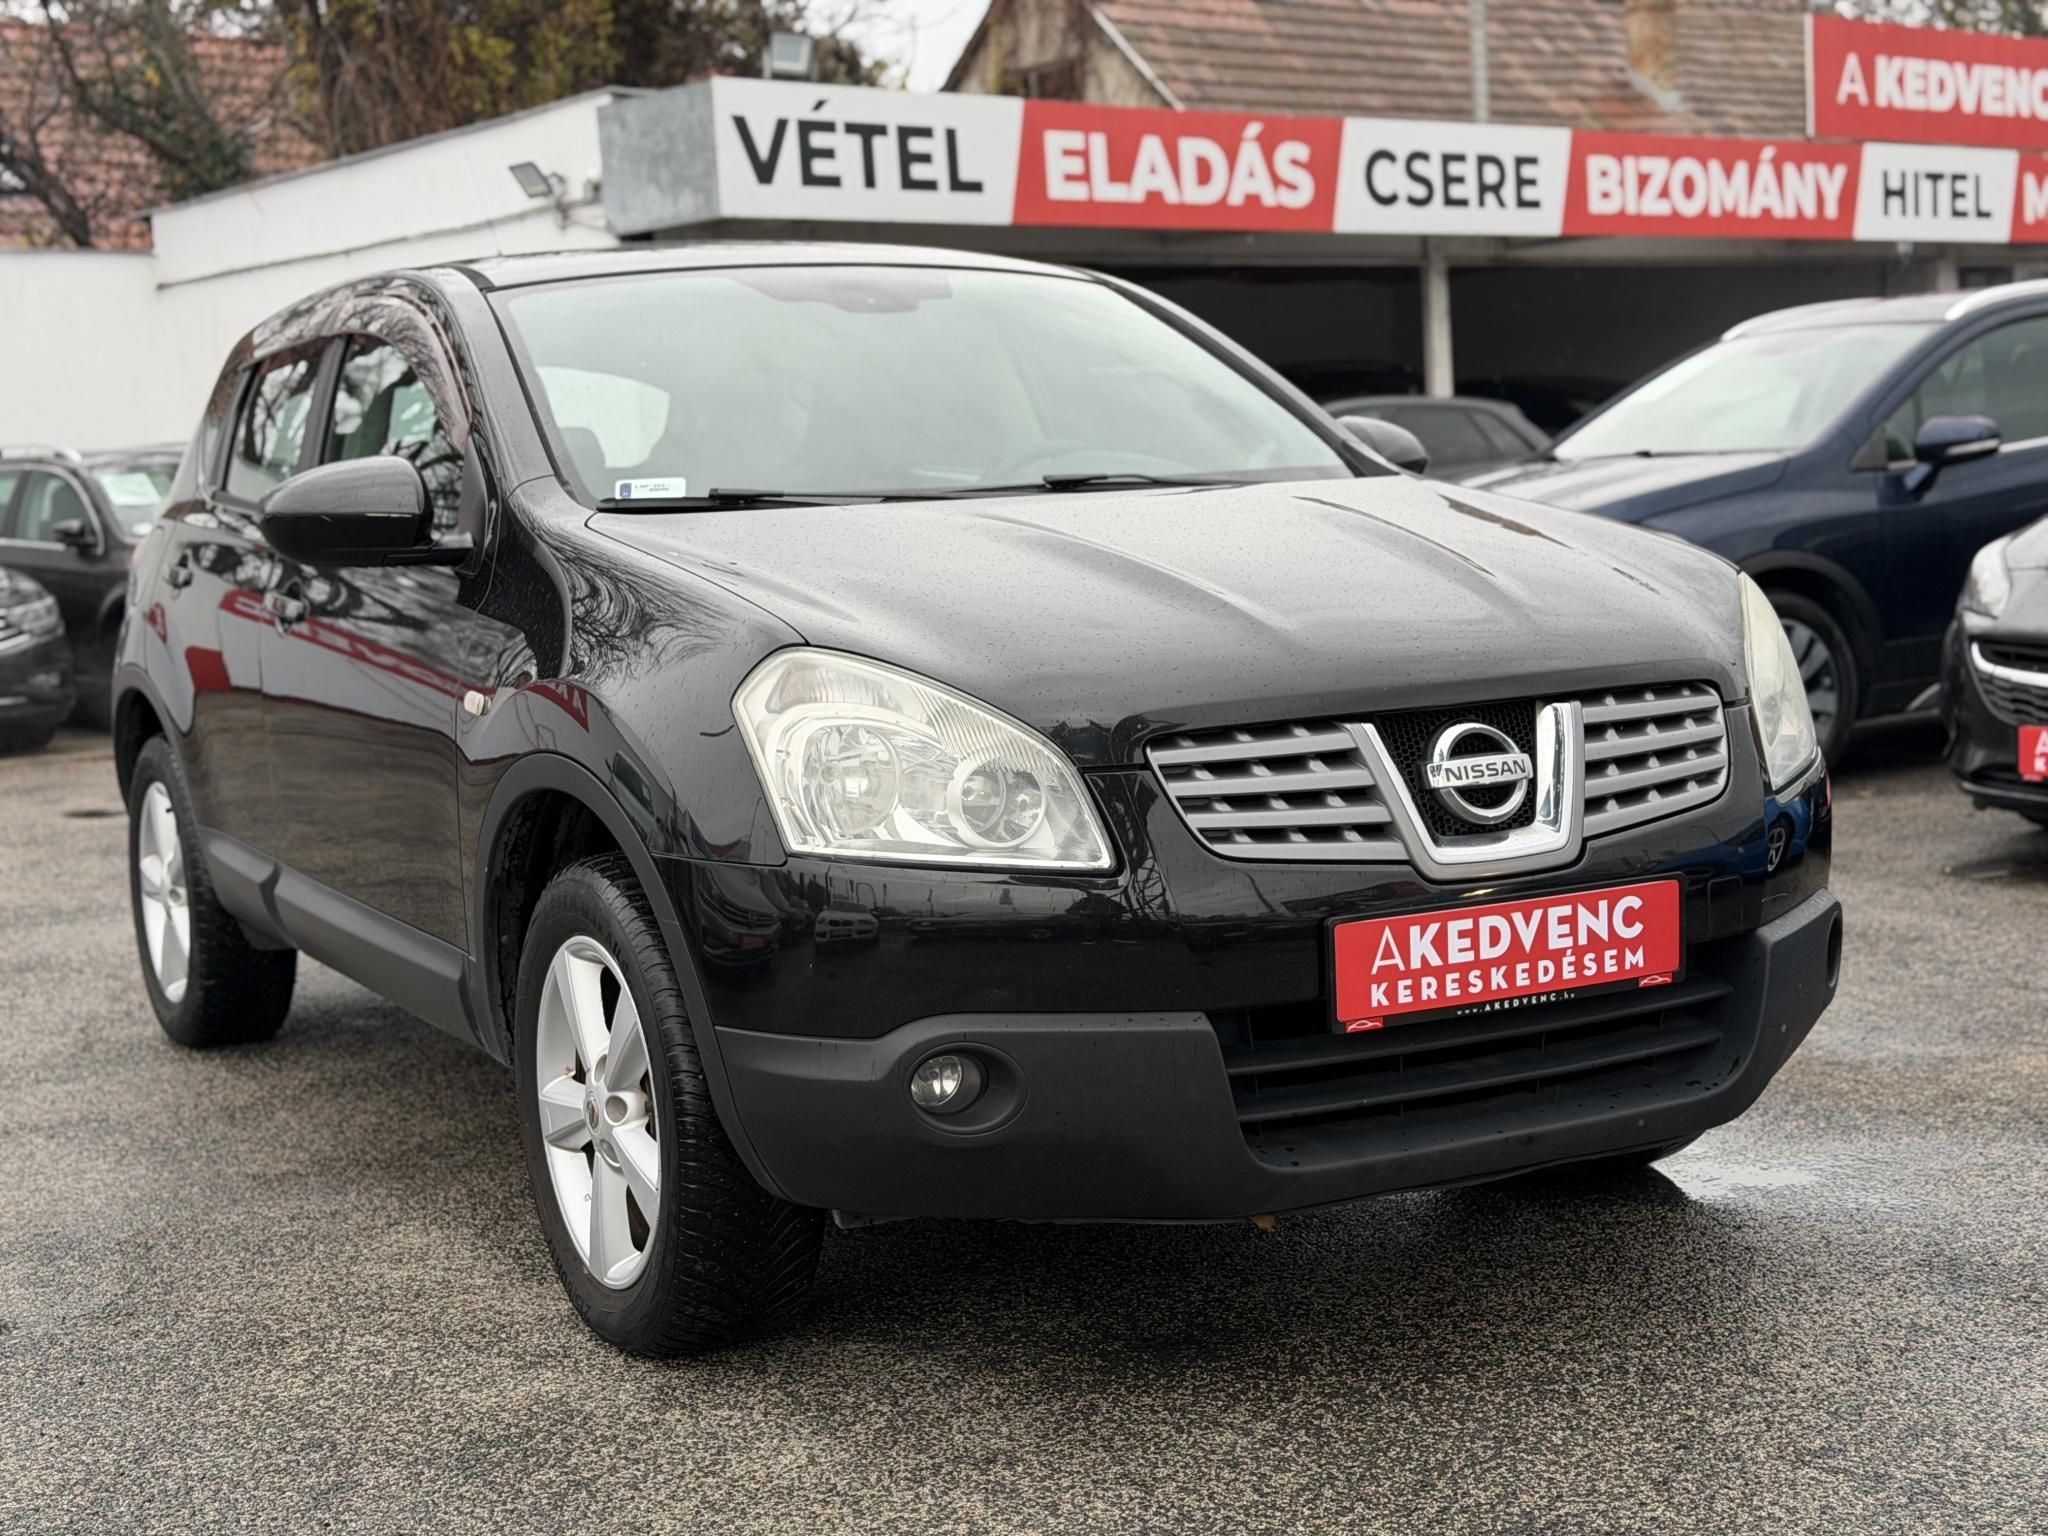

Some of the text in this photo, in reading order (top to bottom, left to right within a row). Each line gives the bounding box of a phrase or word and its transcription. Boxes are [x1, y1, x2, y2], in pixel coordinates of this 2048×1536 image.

[1836, 51, 2048, 121] A KEDVENC
[732, 100, 983, 193] VÉTEL
[1044, 122, 1316, 208] ELADÁS
[1364, 150, 1541, 208] CSERE
[1586, 146, 1848, 220] BIZOMÁNY
[1883, 170, 1992, 218] HITEL
[1444, 759, 1527, 782] NISSAN
[1370, 945, 1645, 1008] KERESKEDÉSEM
